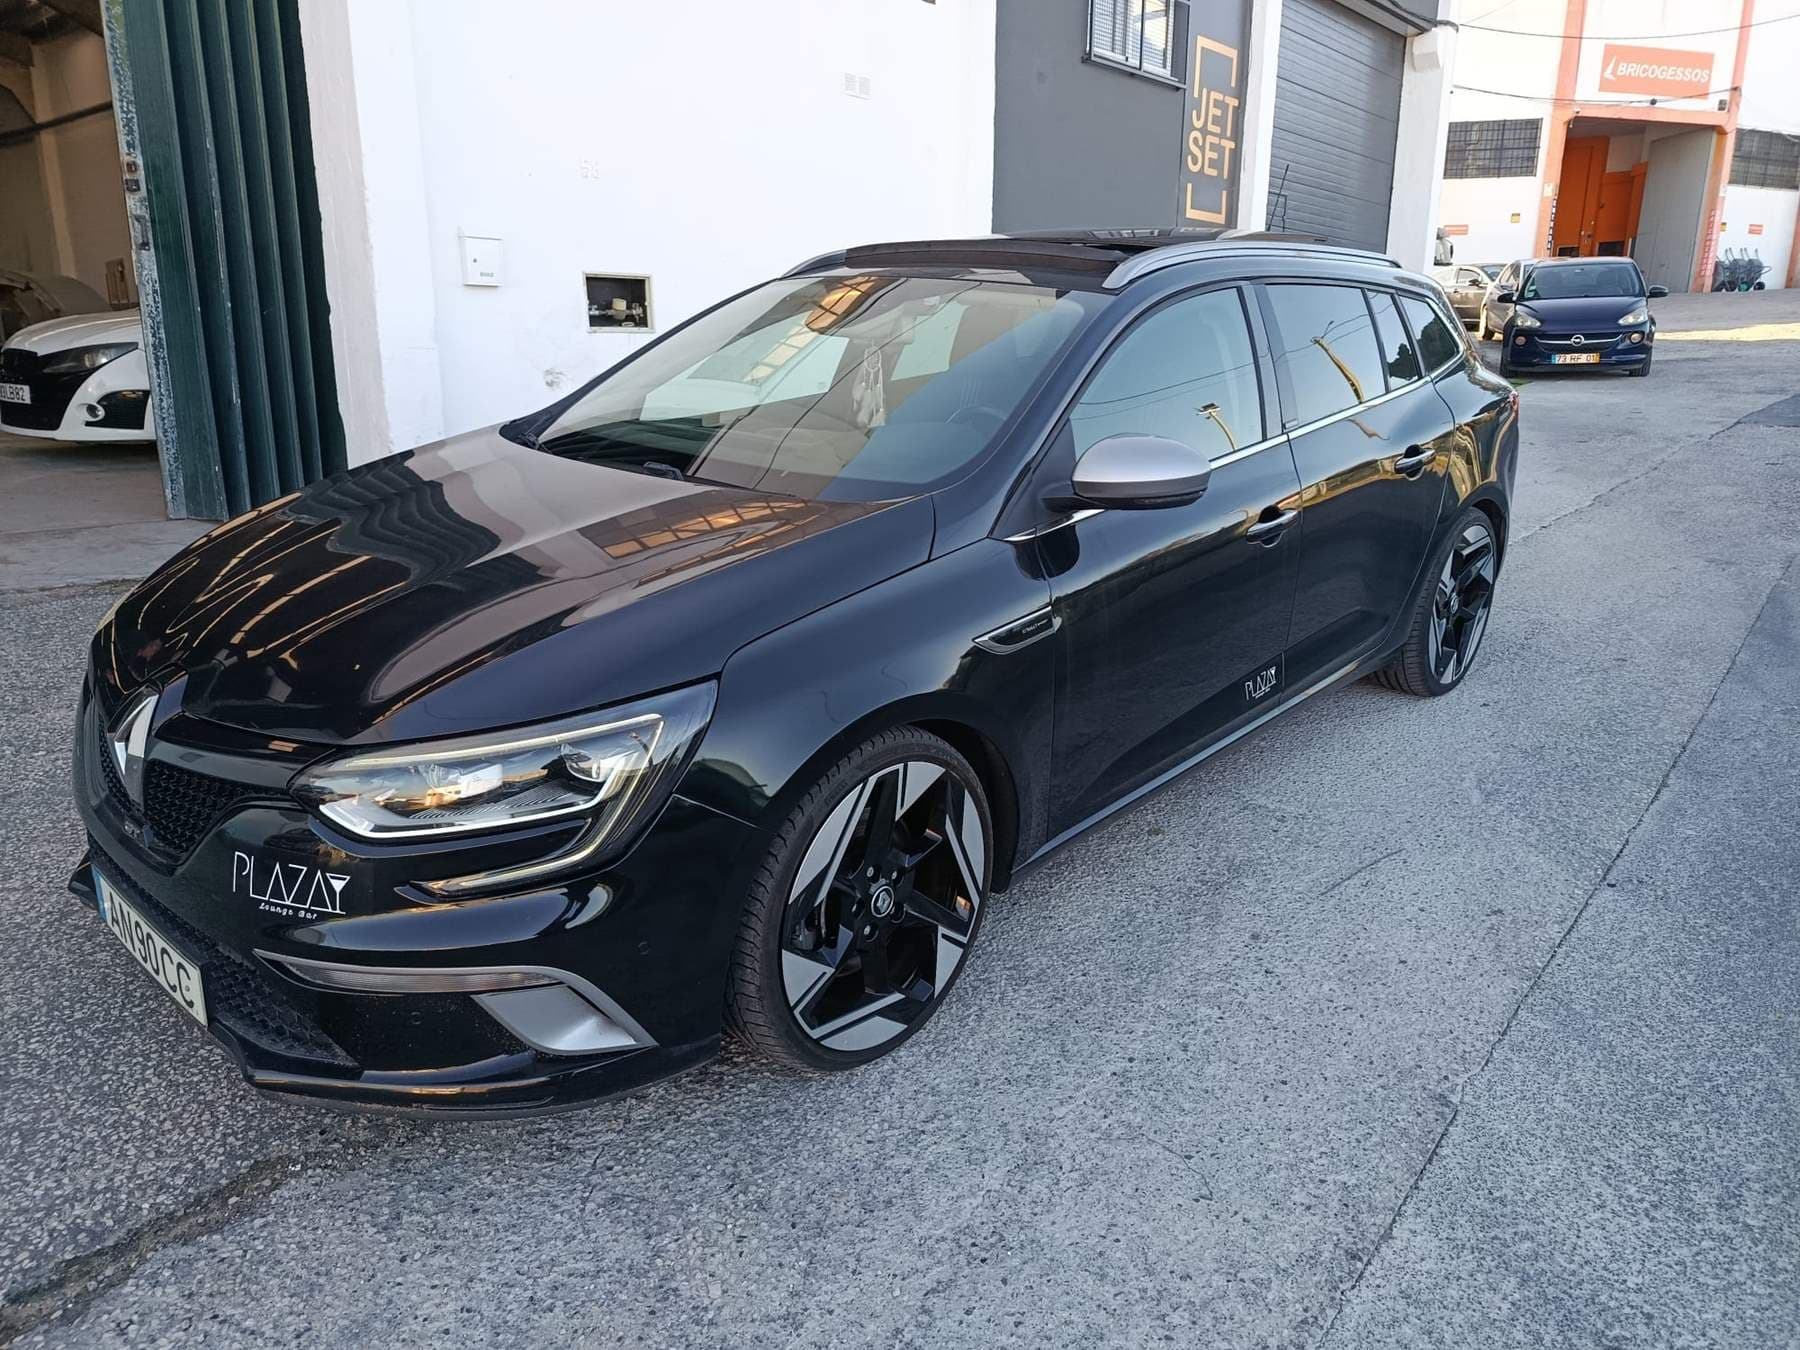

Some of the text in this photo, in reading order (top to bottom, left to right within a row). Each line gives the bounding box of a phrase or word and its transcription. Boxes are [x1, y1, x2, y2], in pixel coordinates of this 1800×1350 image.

[1616, 62, 1710, 83] BRICOGESSOS
[1192, 87, 1239, 137] JET
[1187, 131, 1235, 179] SET
[258, 902, 318, 920] Lounge Bar
[108, 891, 194, 1009] AN90CC
